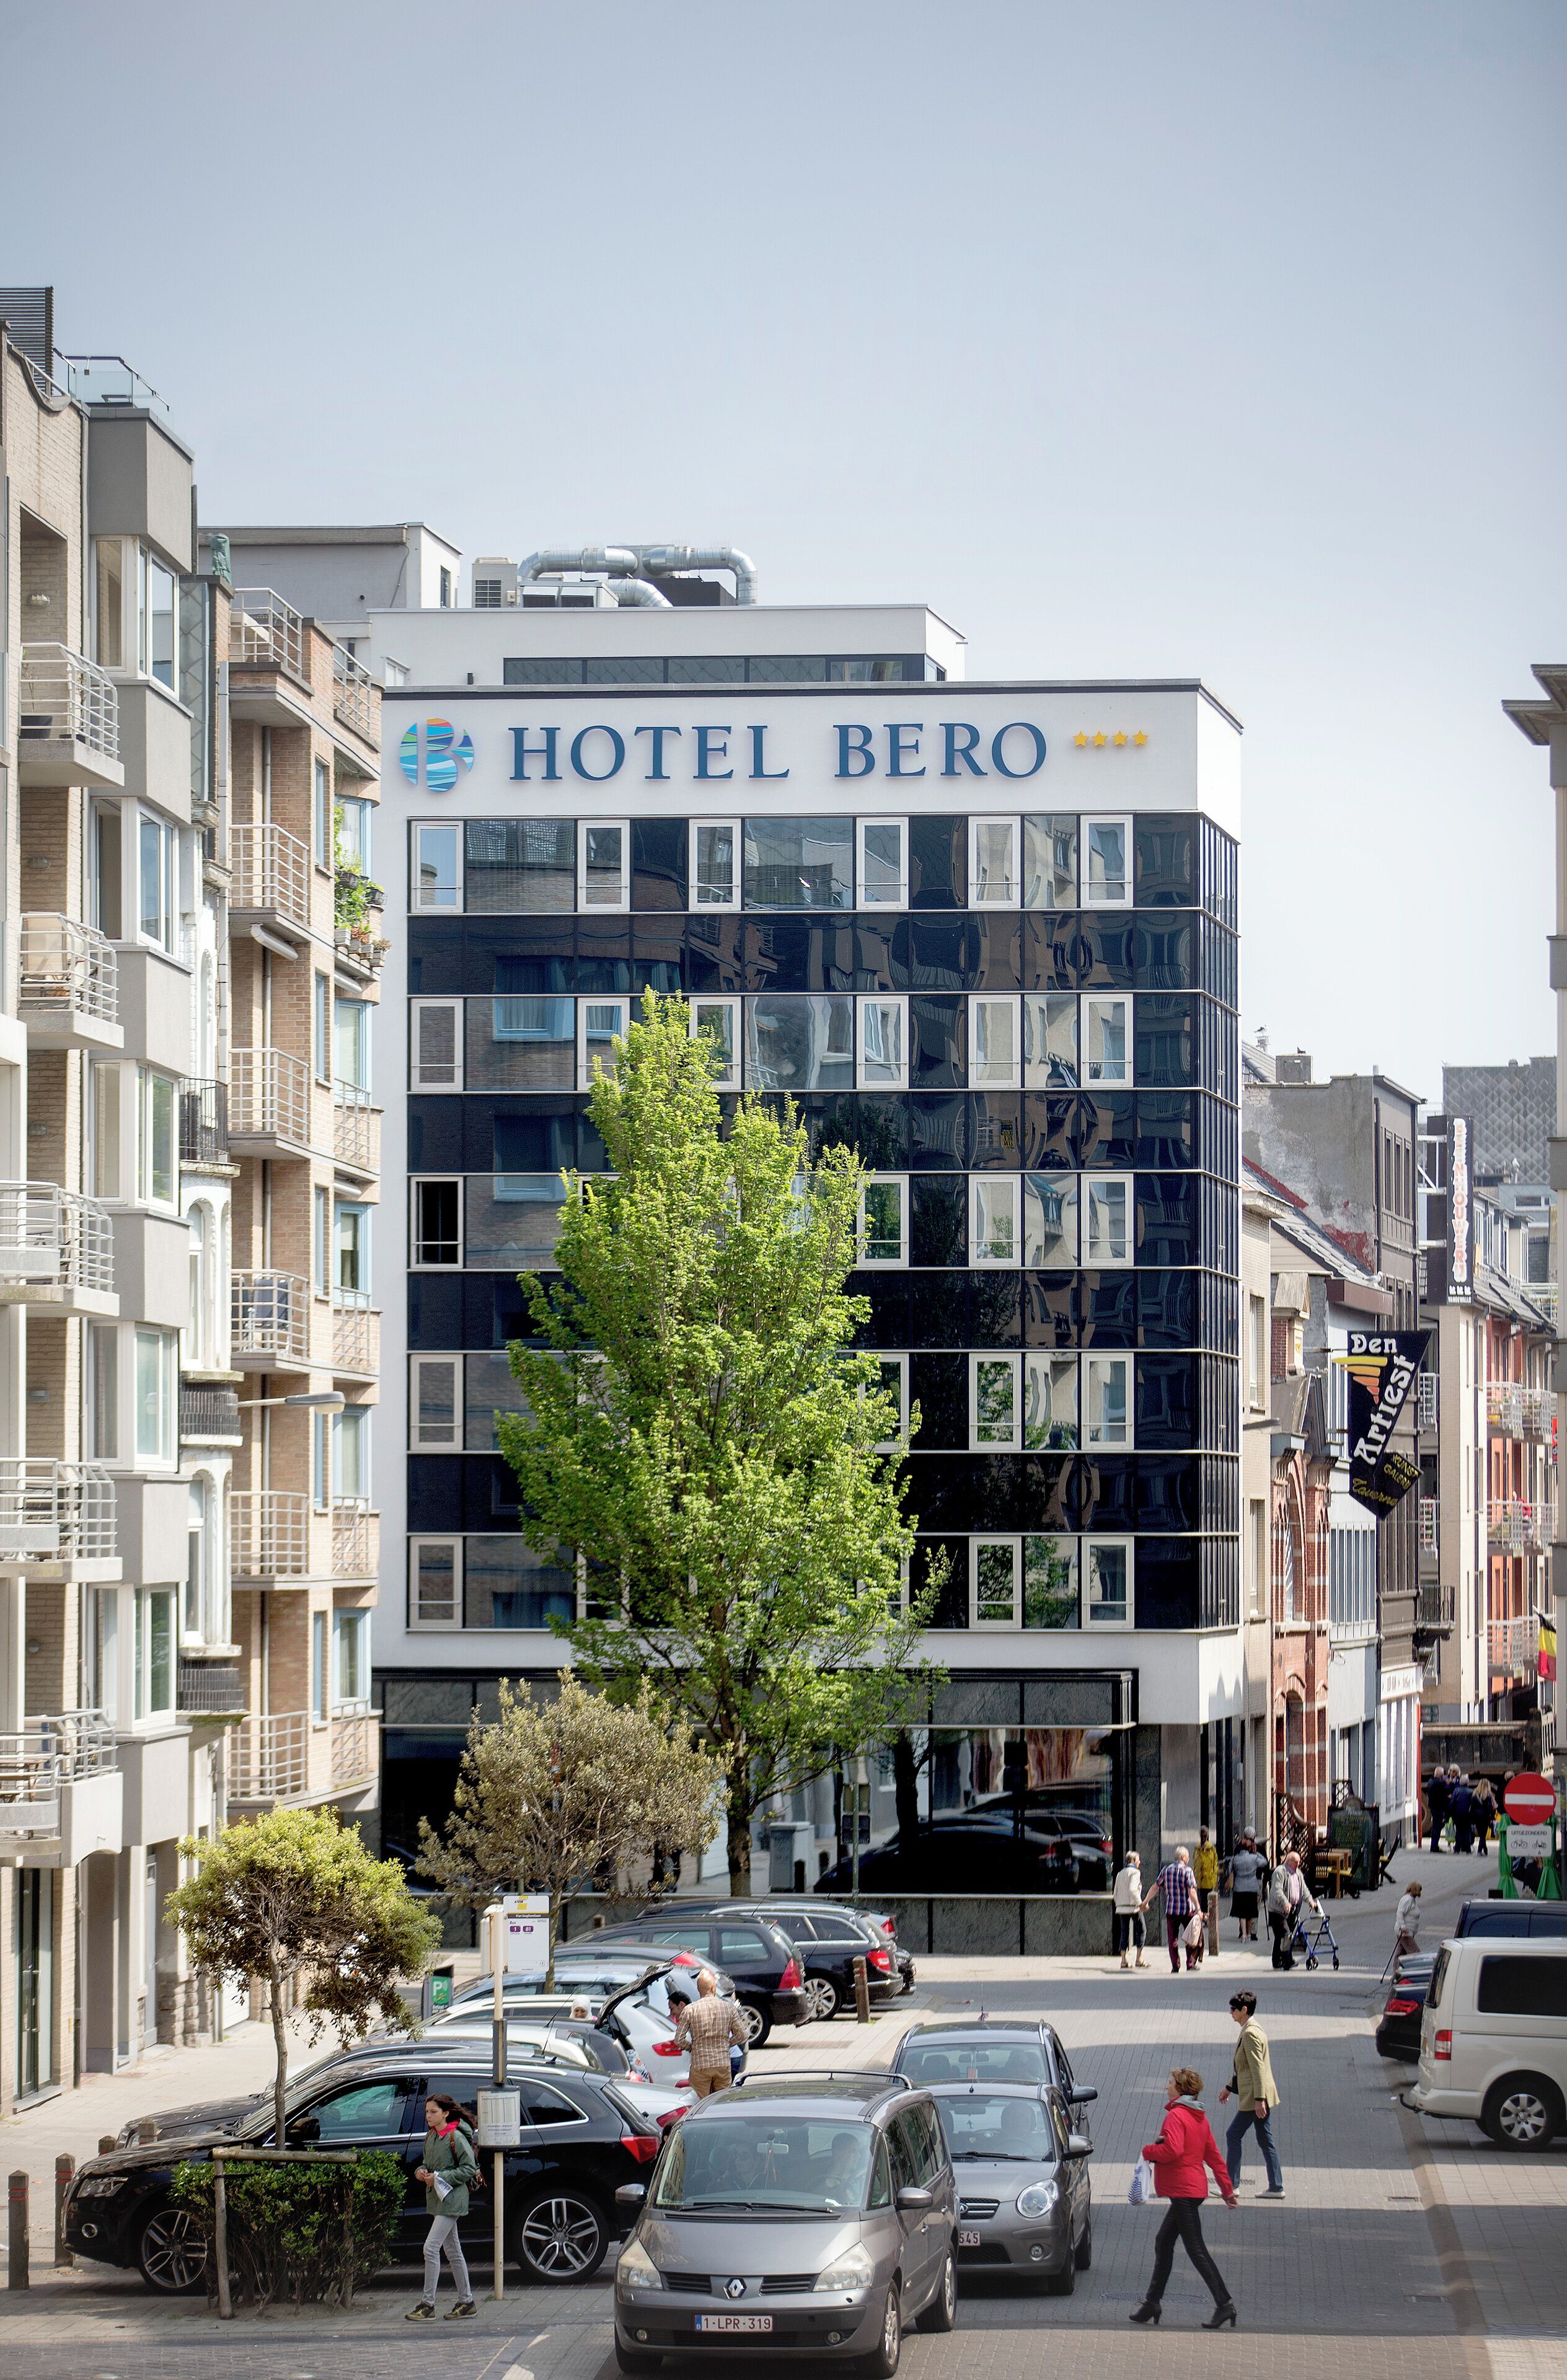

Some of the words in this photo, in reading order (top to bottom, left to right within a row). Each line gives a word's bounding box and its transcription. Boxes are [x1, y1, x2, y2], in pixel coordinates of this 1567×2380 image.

[508, 725, 790, 781] HOTEL
[832, 722, 1047, 778] BERO
[1350, 1334, 1397, 1354] Den
[1353, 1354, 1415, 1466] Artiest
[1392, 1453, 1419, 1479] KUNST
[959, 2232, 978, 2244] 545
[704, 2317, 771, 2329] 1-LPR-319
